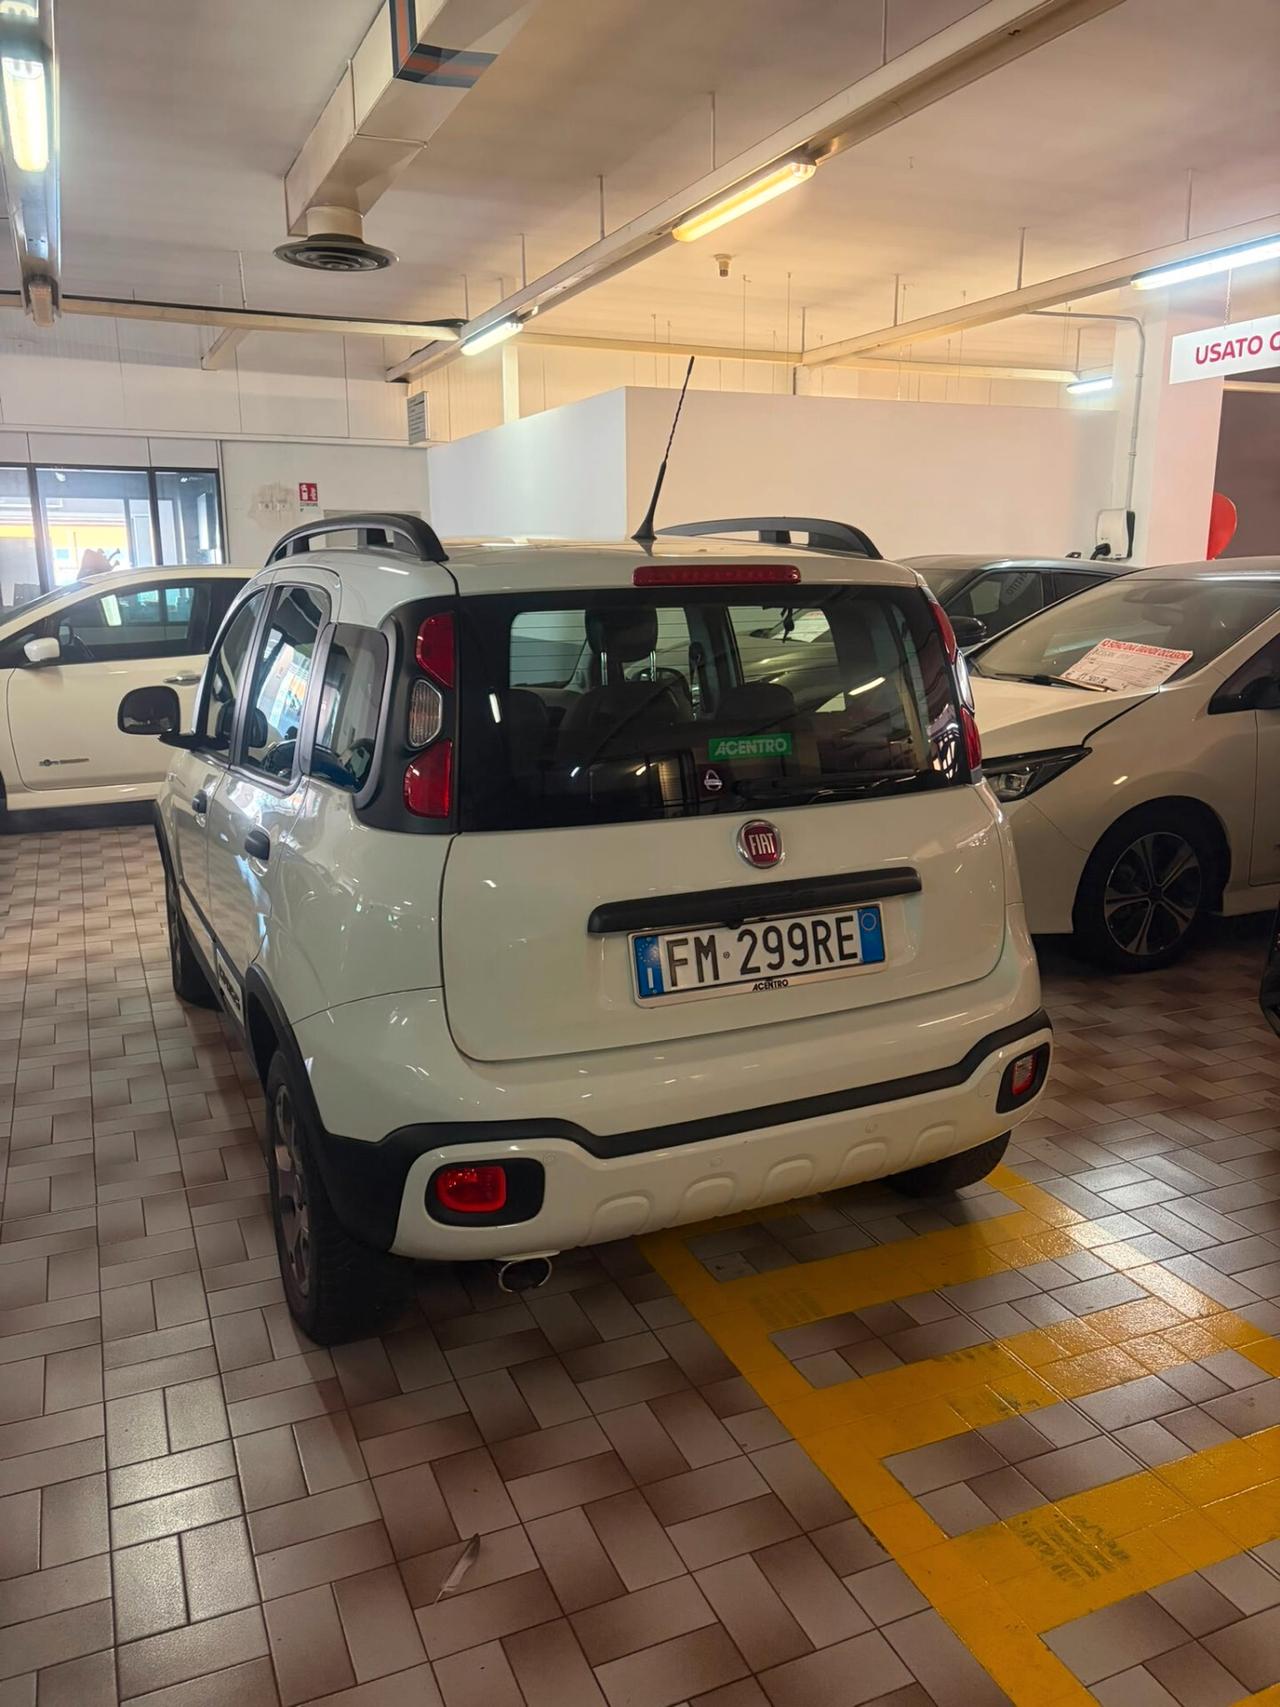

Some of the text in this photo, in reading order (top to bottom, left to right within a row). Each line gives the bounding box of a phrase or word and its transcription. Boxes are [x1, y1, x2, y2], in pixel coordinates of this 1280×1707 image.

[1195, 335, 1263, 365] USATO
[715, 738, 787, 756] ACENTRO
[748, 833, 775, 856] FIAT
[666, 934, 720, 988] FM
[736, 915, 859, 976] 299RE
[752, 979, 789, 991] ACENTRO
